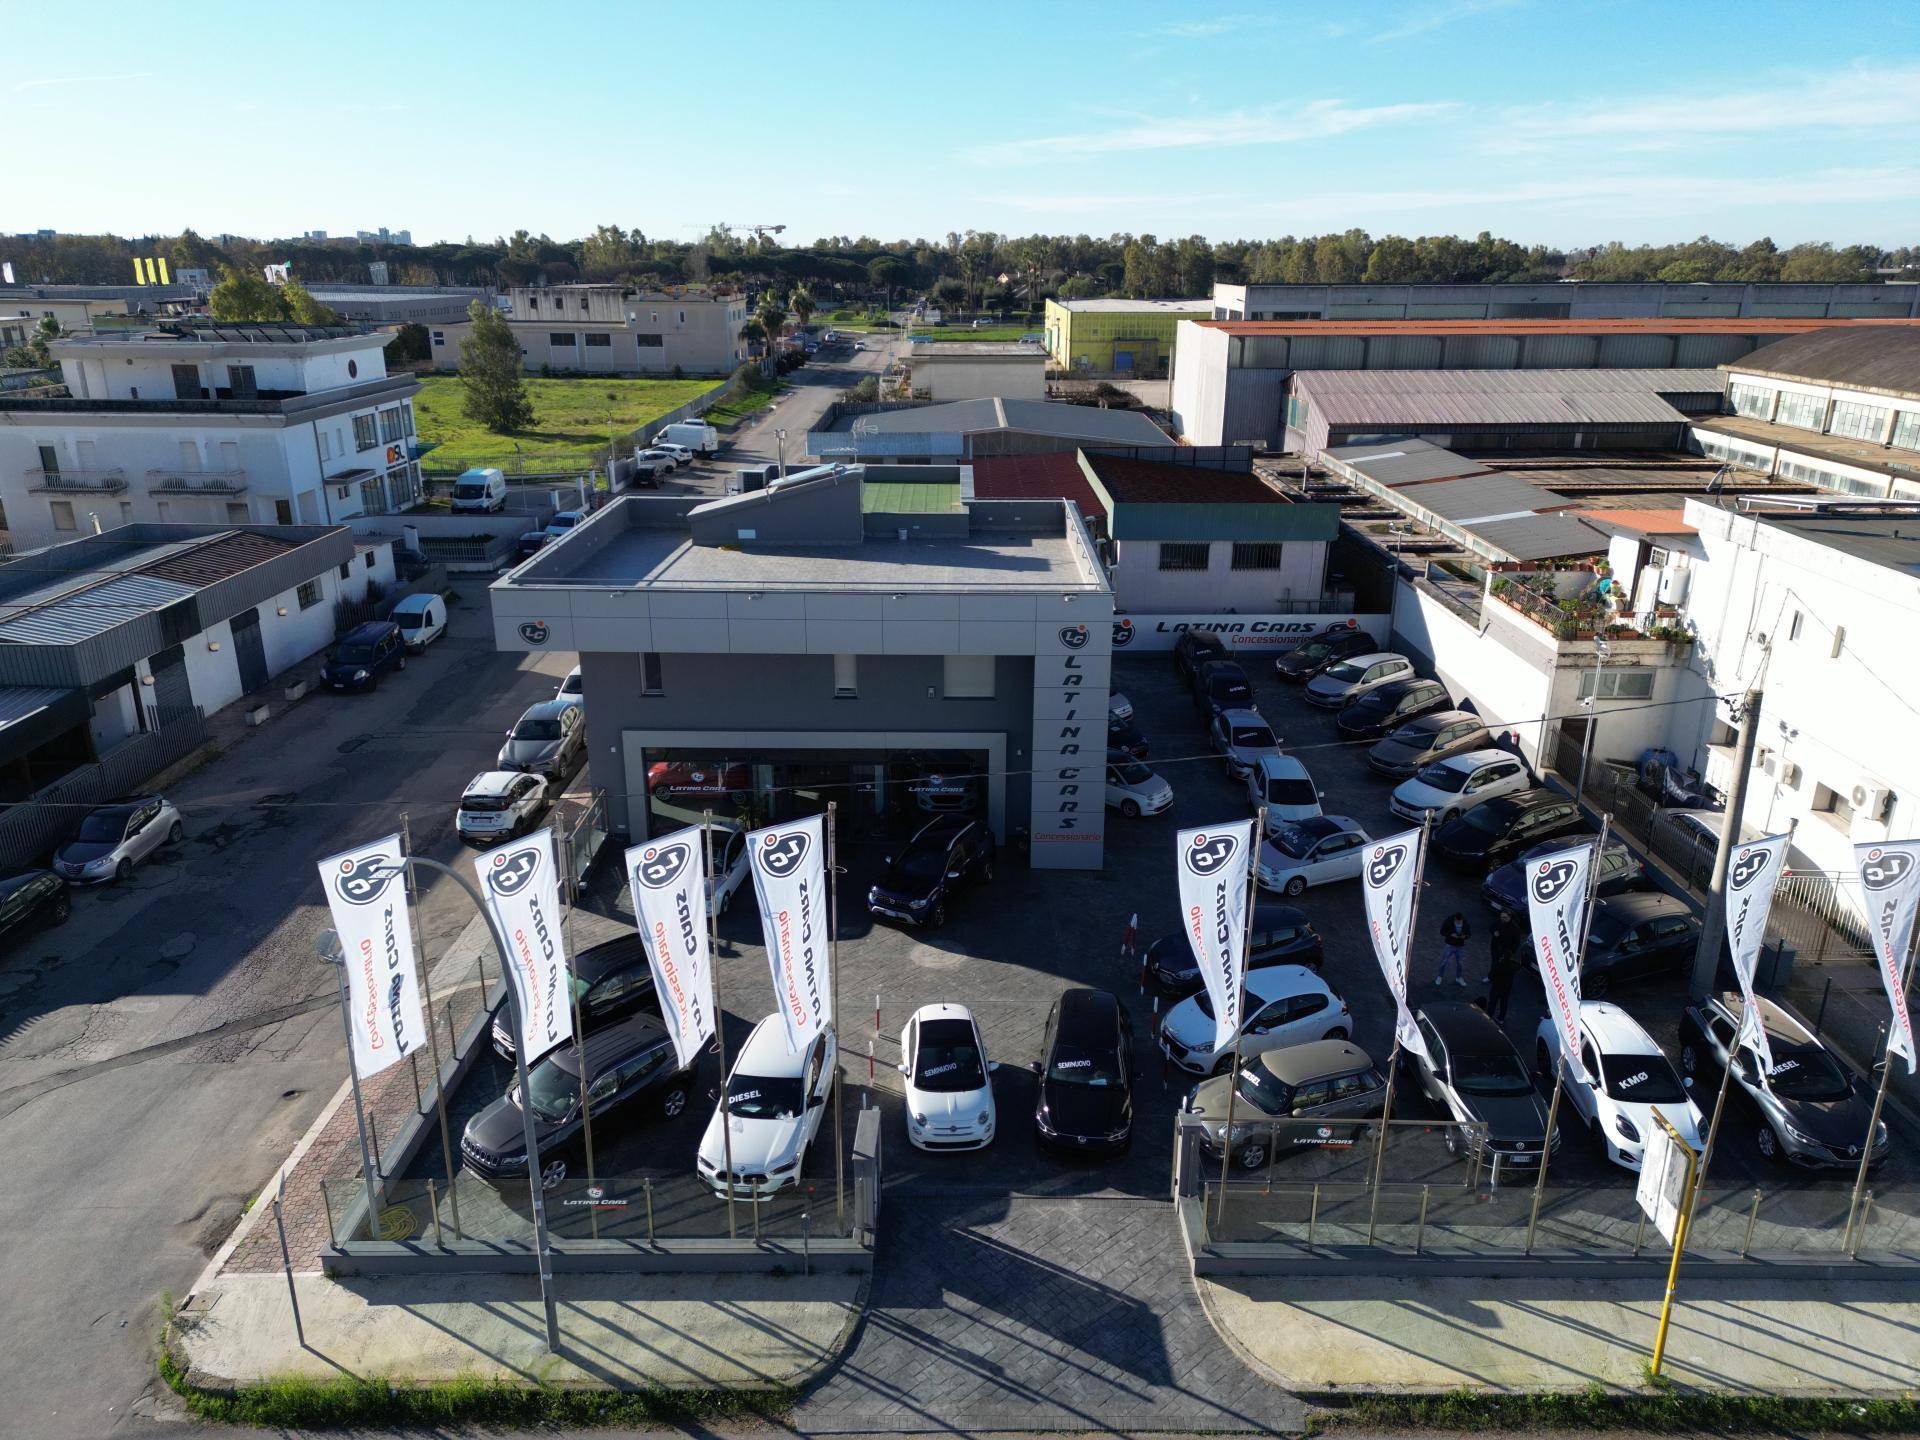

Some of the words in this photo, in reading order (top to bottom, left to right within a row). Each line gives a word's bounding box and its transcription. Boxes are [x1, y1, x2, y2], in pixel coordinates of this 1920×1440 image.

[1156, 621, 1245, 633] LATINA
[1249, 621, 1317, 632] CARS
[1035, 832, 1102, 842] Concessionario
[1768, 1060, 1801, 1076] DIESEL
[728, 1089, 762, 1104] DIESEL
